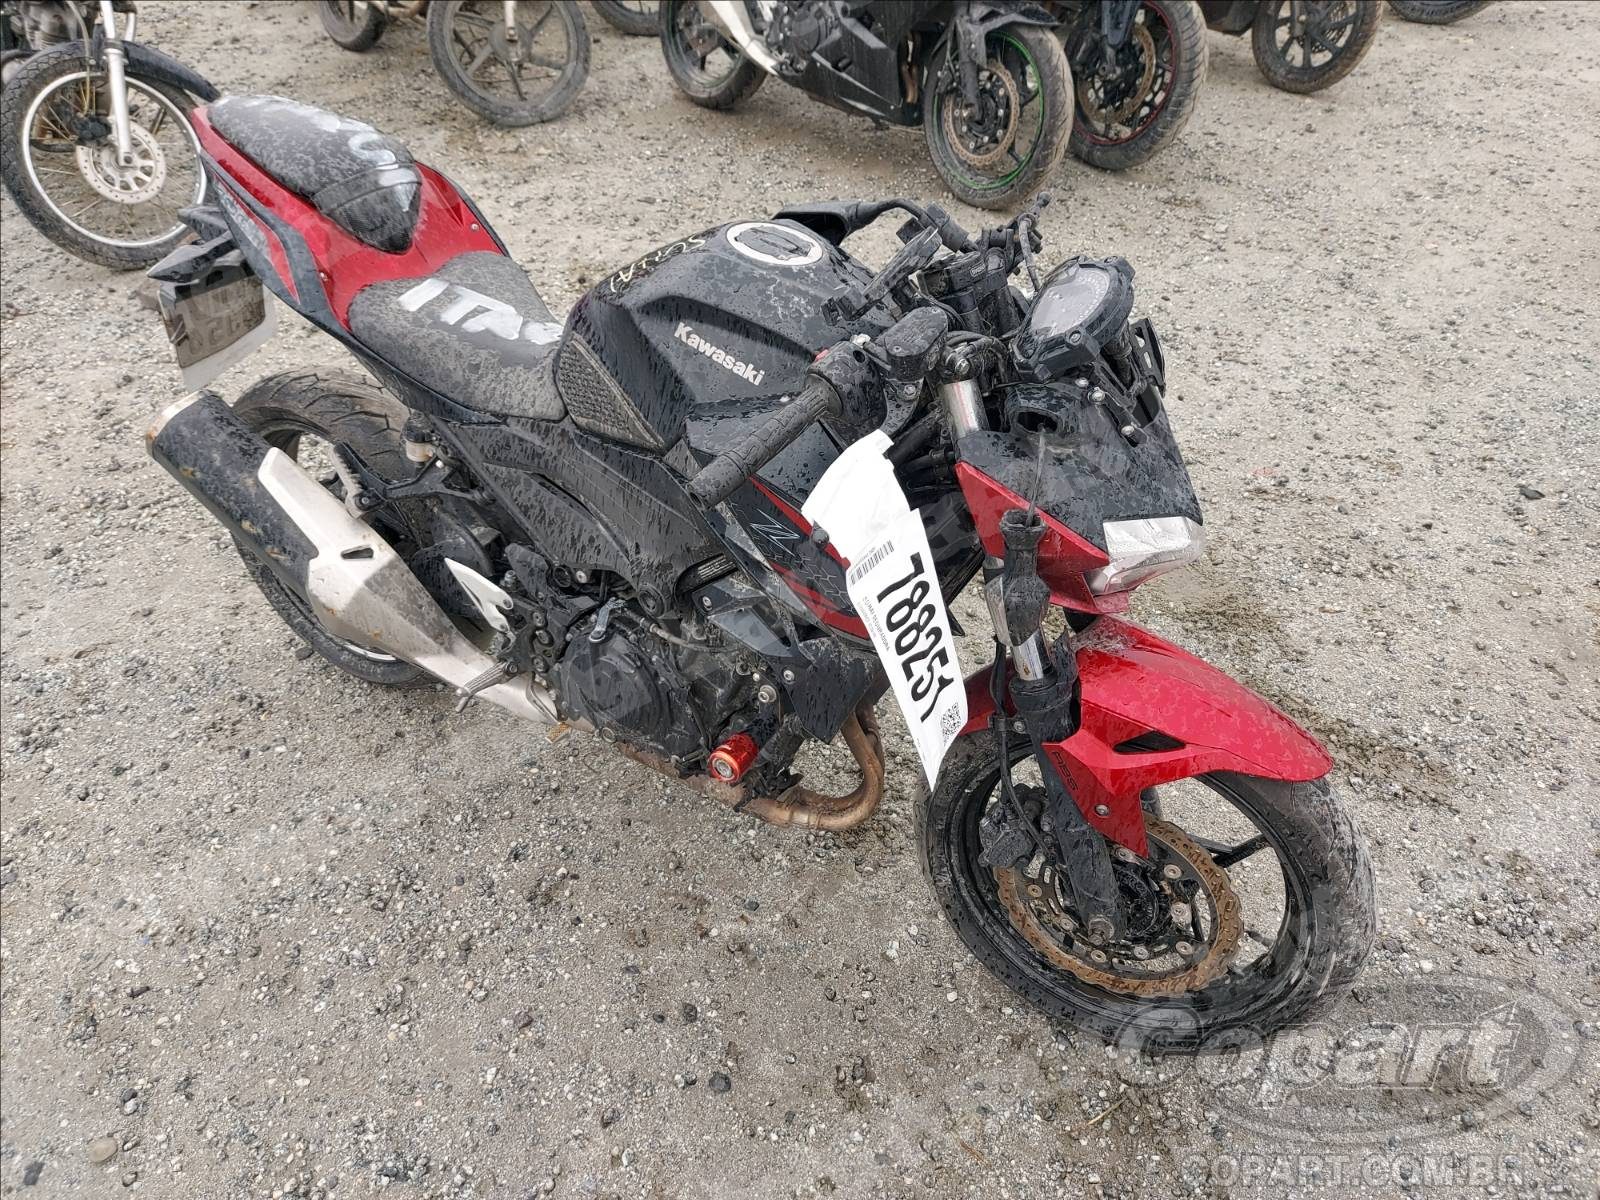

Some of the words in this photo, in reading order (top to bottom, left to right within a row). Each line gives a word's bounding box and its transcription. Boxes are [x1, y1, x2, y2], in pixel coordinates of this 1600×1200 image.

[673, 321, 766, 386] Kawasaki
[876, 552, 953, 723] 788251
[1051, 750, 1079, 791] ABS
